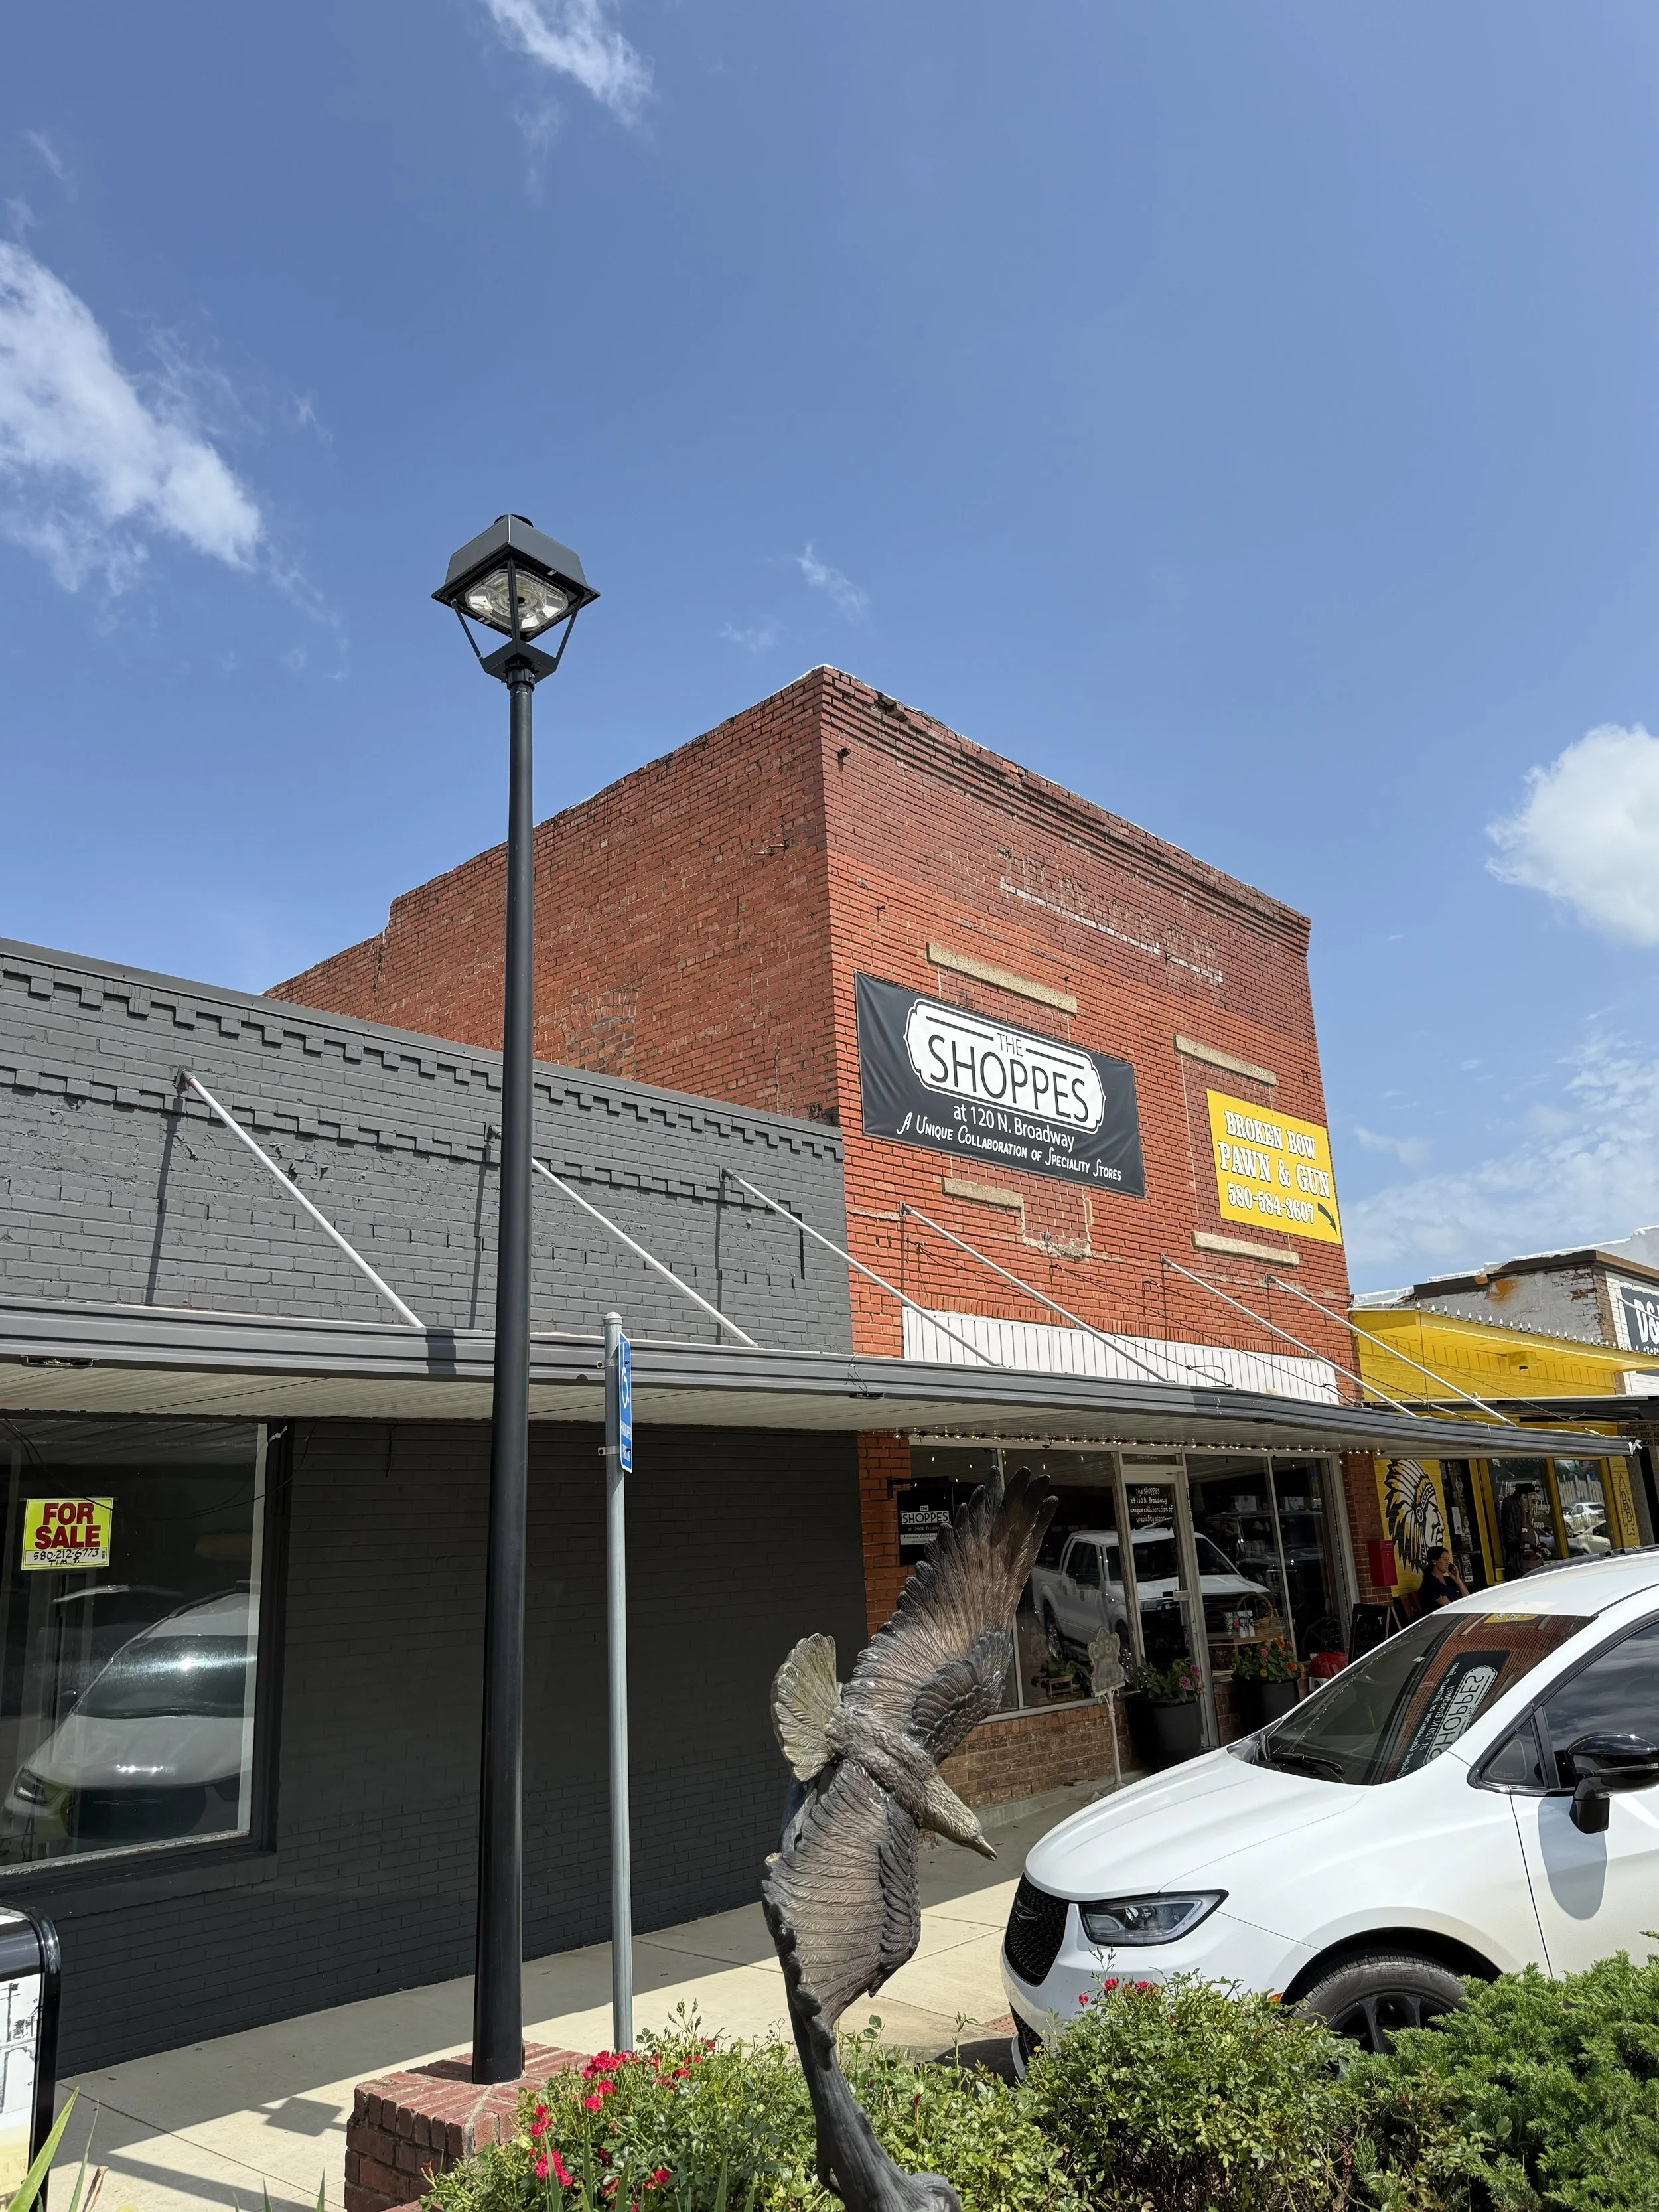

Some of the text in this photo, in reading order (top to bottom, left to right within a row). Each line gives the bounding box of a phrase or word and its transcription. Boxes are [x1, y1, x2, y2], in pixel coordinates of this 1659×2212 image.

[997, 1033, 1023, 1057] THE
[929, 1034, 1088, 1122] SHOPPES
[897, 1112, 912, 1134] A
[954, 1104, 1074, 1152] at 120 N. Broadway
[1224, 1110, 1315, 1160] BROKEN BOW
[1217, 1141, 1331, 1199] PAWN & GUN
[1228, 1181, 1315, 1224] 580-584-3607
[43, 1502, 94, 1525] FOR
[903, 1512, 948, 1524] SHOPPES
[35, 1526, 101, 1550] SALE
